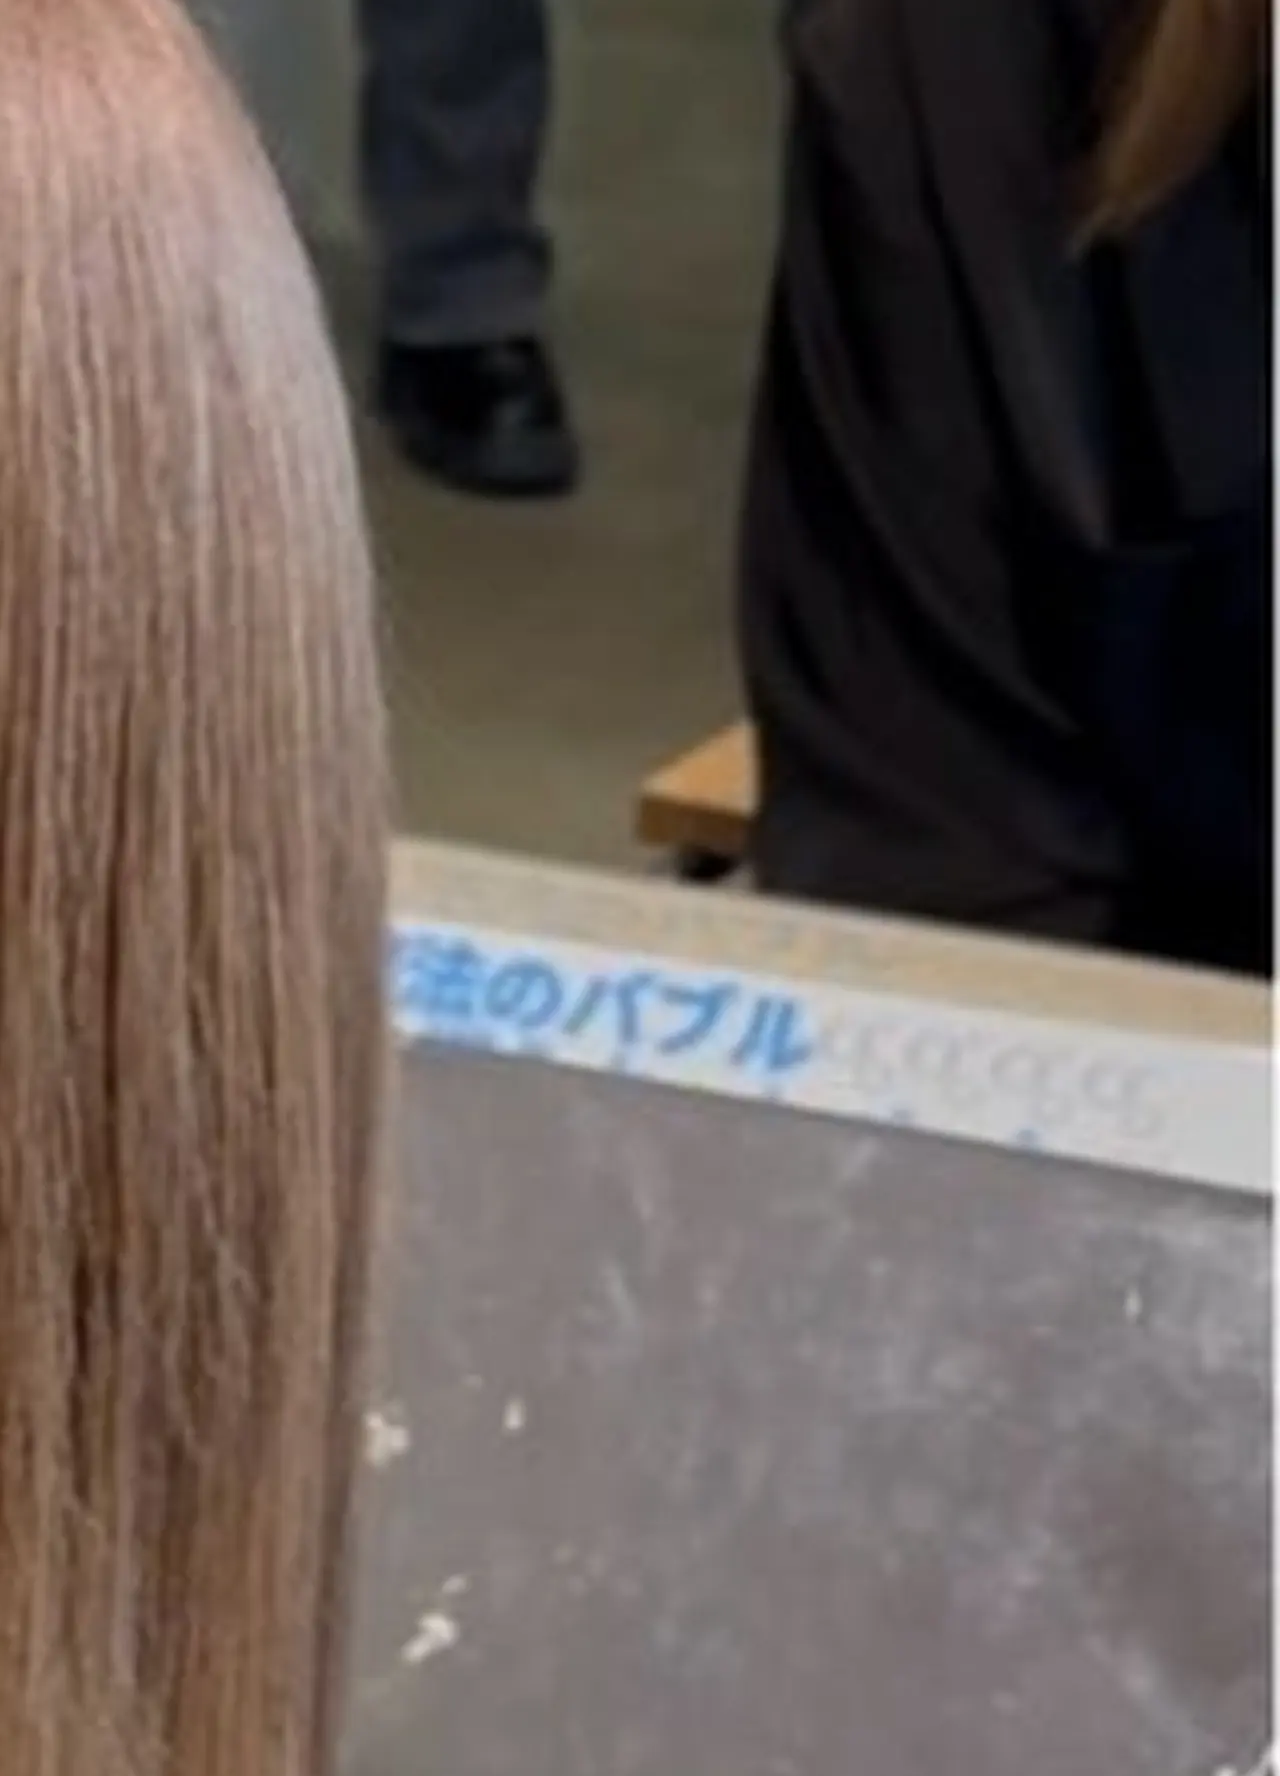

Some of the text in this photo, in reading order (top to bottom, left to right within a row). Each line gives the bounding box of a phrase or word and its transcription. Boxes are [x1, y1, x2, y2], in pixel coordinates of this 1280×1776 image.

[390, 927, 816, 1072] 法のバブル
